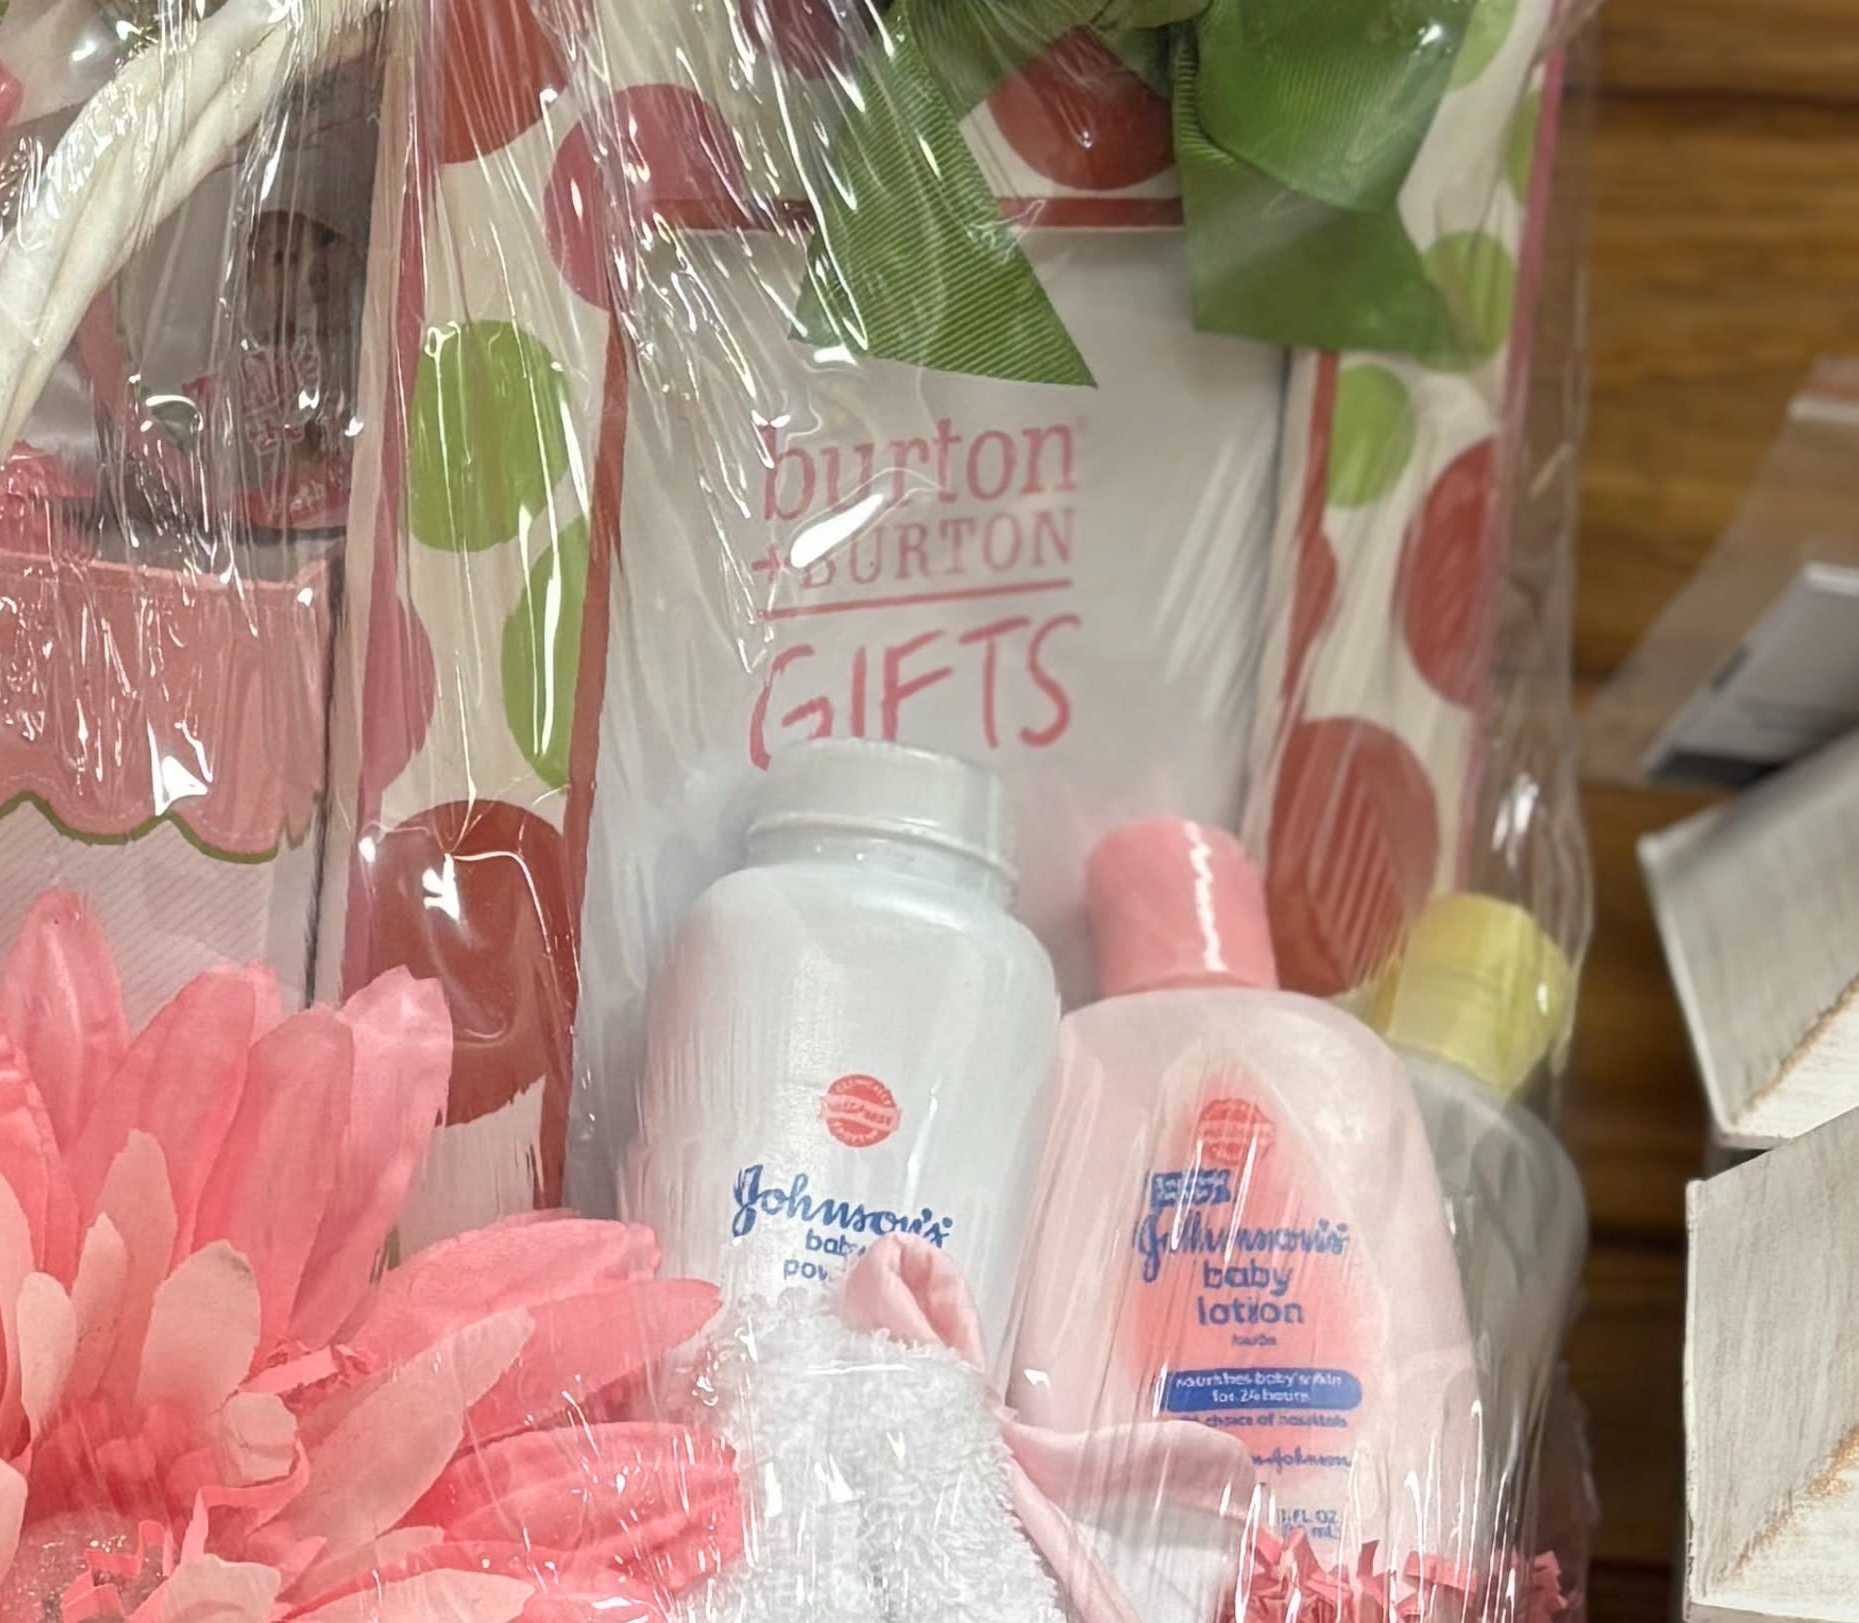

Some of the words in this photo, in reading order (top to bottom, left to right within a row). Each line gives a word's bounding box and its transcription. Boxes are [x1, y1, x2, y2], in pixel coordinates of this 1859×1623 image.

[759, 416, 1079, 521] burton
[749, 612, 1081, 771] GIFTS
[732, 1164, 953, 1248] Johnson's
[805, 1228, 866, 1256] bab
[1203, 1258, 1293, 1297] baby
[1197, 1296, 1305, 1325] lotion
[1212, 1389, 1235, 1402] for
